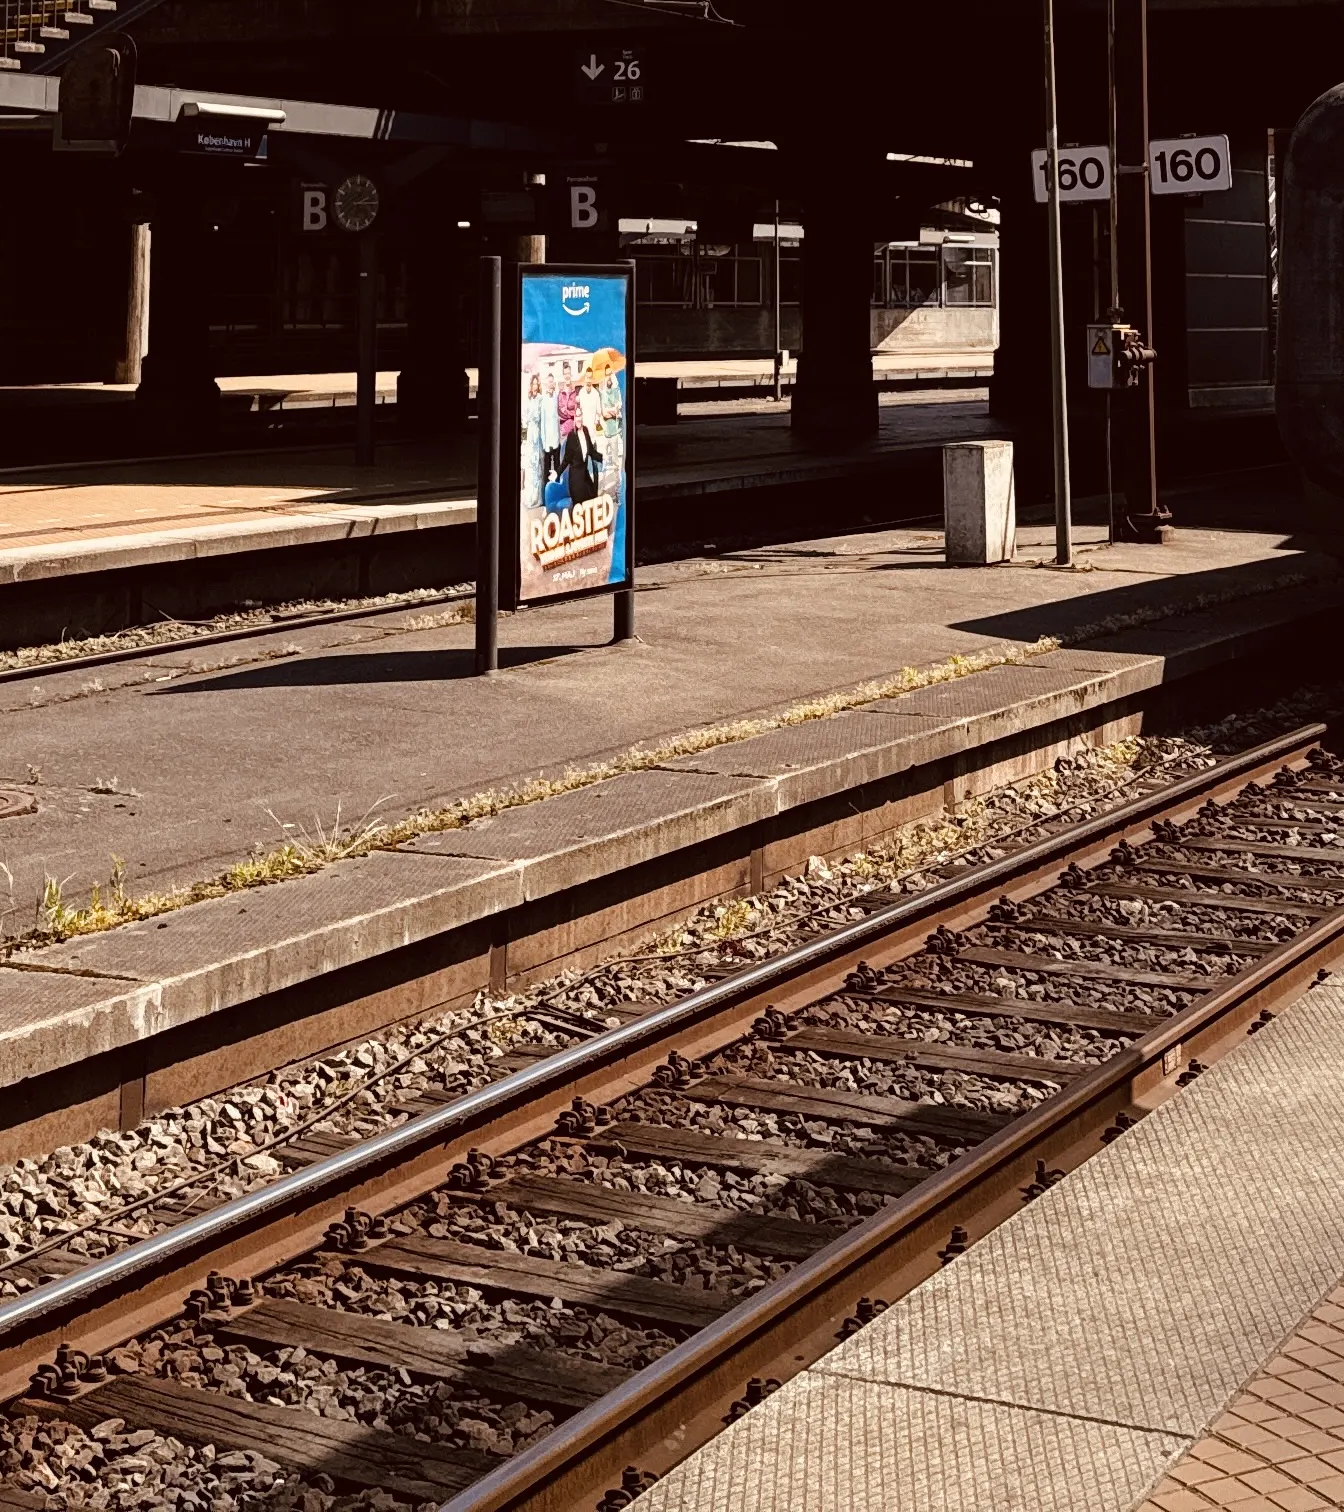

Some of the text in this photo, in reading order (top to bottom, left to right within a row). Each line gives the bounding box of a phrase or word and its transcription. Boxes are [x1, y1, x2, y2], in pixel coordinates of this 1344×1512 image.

[613, 60, 641, 81] 26
[244, 137, 251, 148] H
[1039, 156, 1105, 191] 160
[1154, 147, 1221, 183] 160
[303, 190, 327, 231] B
[570, 186, 598, 228] B
[562, 281, 590, 303] prime
[530, 493, 614, 553] ROASTED
